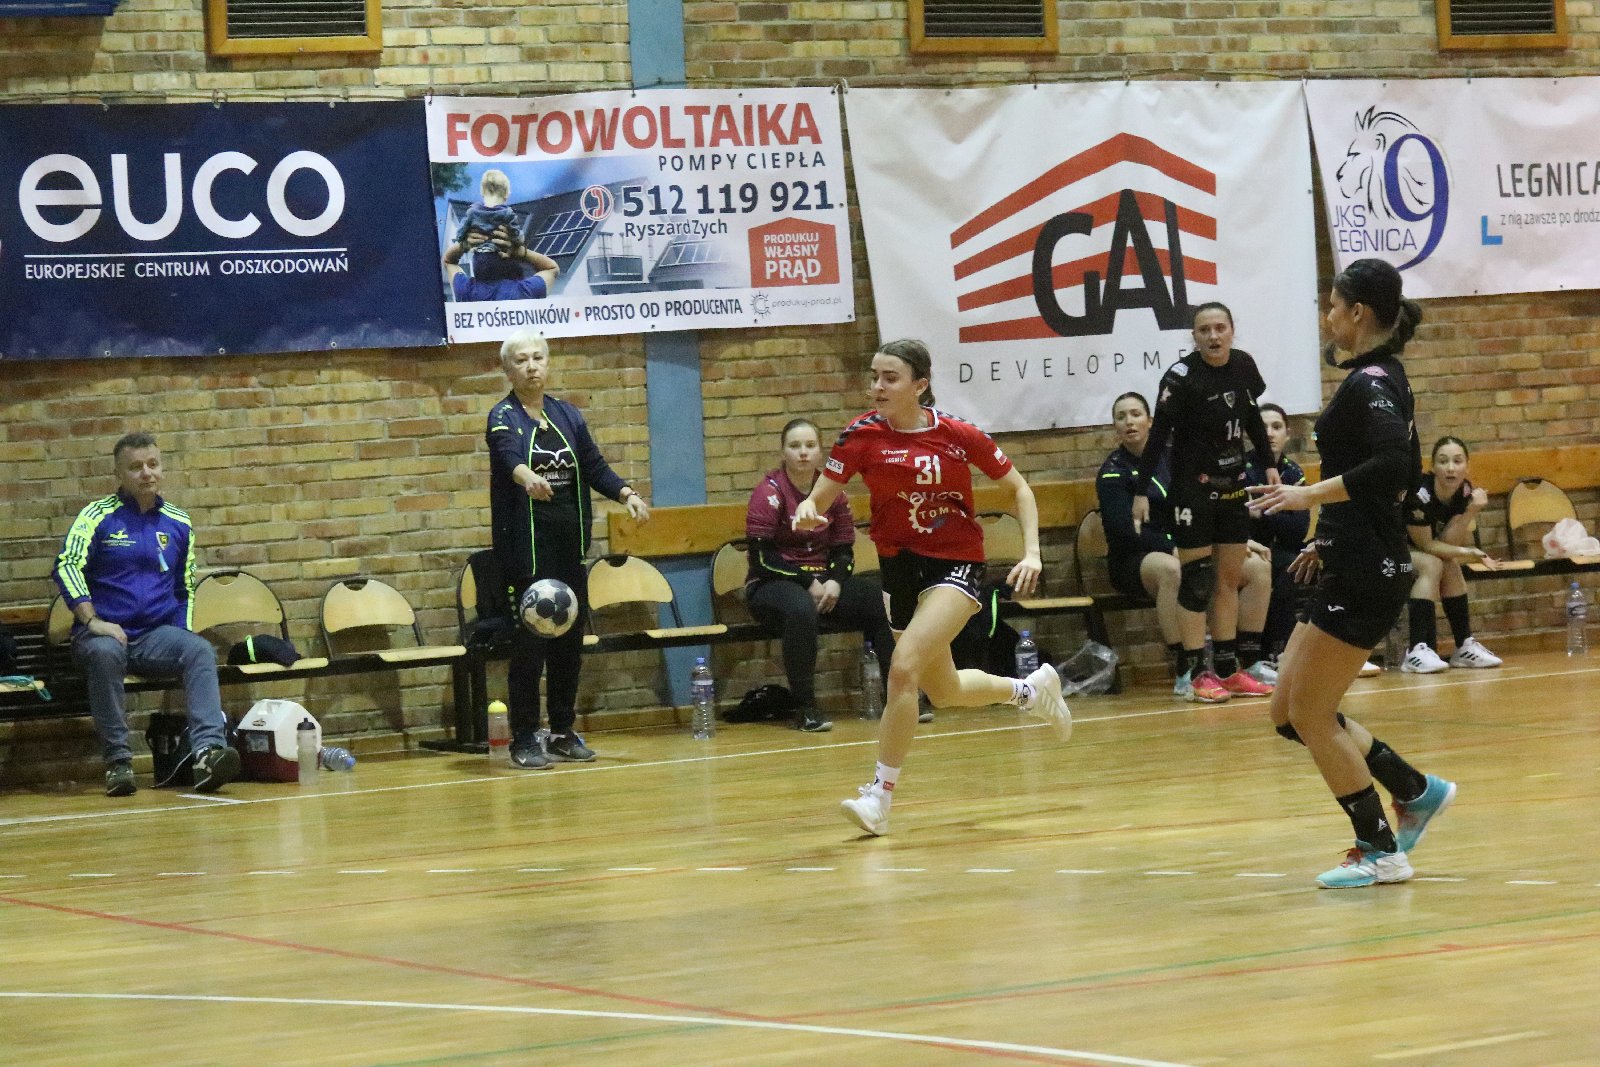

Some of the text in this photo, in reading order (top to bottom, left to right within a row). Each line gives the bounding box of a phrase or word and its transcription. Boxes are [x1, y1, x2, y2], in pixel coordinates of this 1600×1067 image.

[446, 102, 823, 157] FOTOWOLTAIKA
[658, 151, 826, 172] POMPY CIEPŁA
[1497, 161, 1600, 198] LEGNICA
[622, 180, 834, 217] 512 119 921
[1524, 212, 1557, 225] zawsze
[1559, 211, 1571, 228] po
[763, 232, 820, 244] PRODUKUJ
[764, 243, 820, 258] WŁASNY
[1337, 228, 1418, 253] EGNICA
[25, 253, 349, 279] EUROPEJSKIE CENTRUM ODSZKODOWAŃ
[765, 258, 822, 284] PRĄD
[454, 298, 744, 329] BEZ POŚREDNIKÓW PROSTO OD PRODUCENTA
[1225, 418, 1242, 441] 14
[914, 454, 942, 485] 31
[1174, 505, 1194, 527] 14
[950, 563, 972, 580] 31
